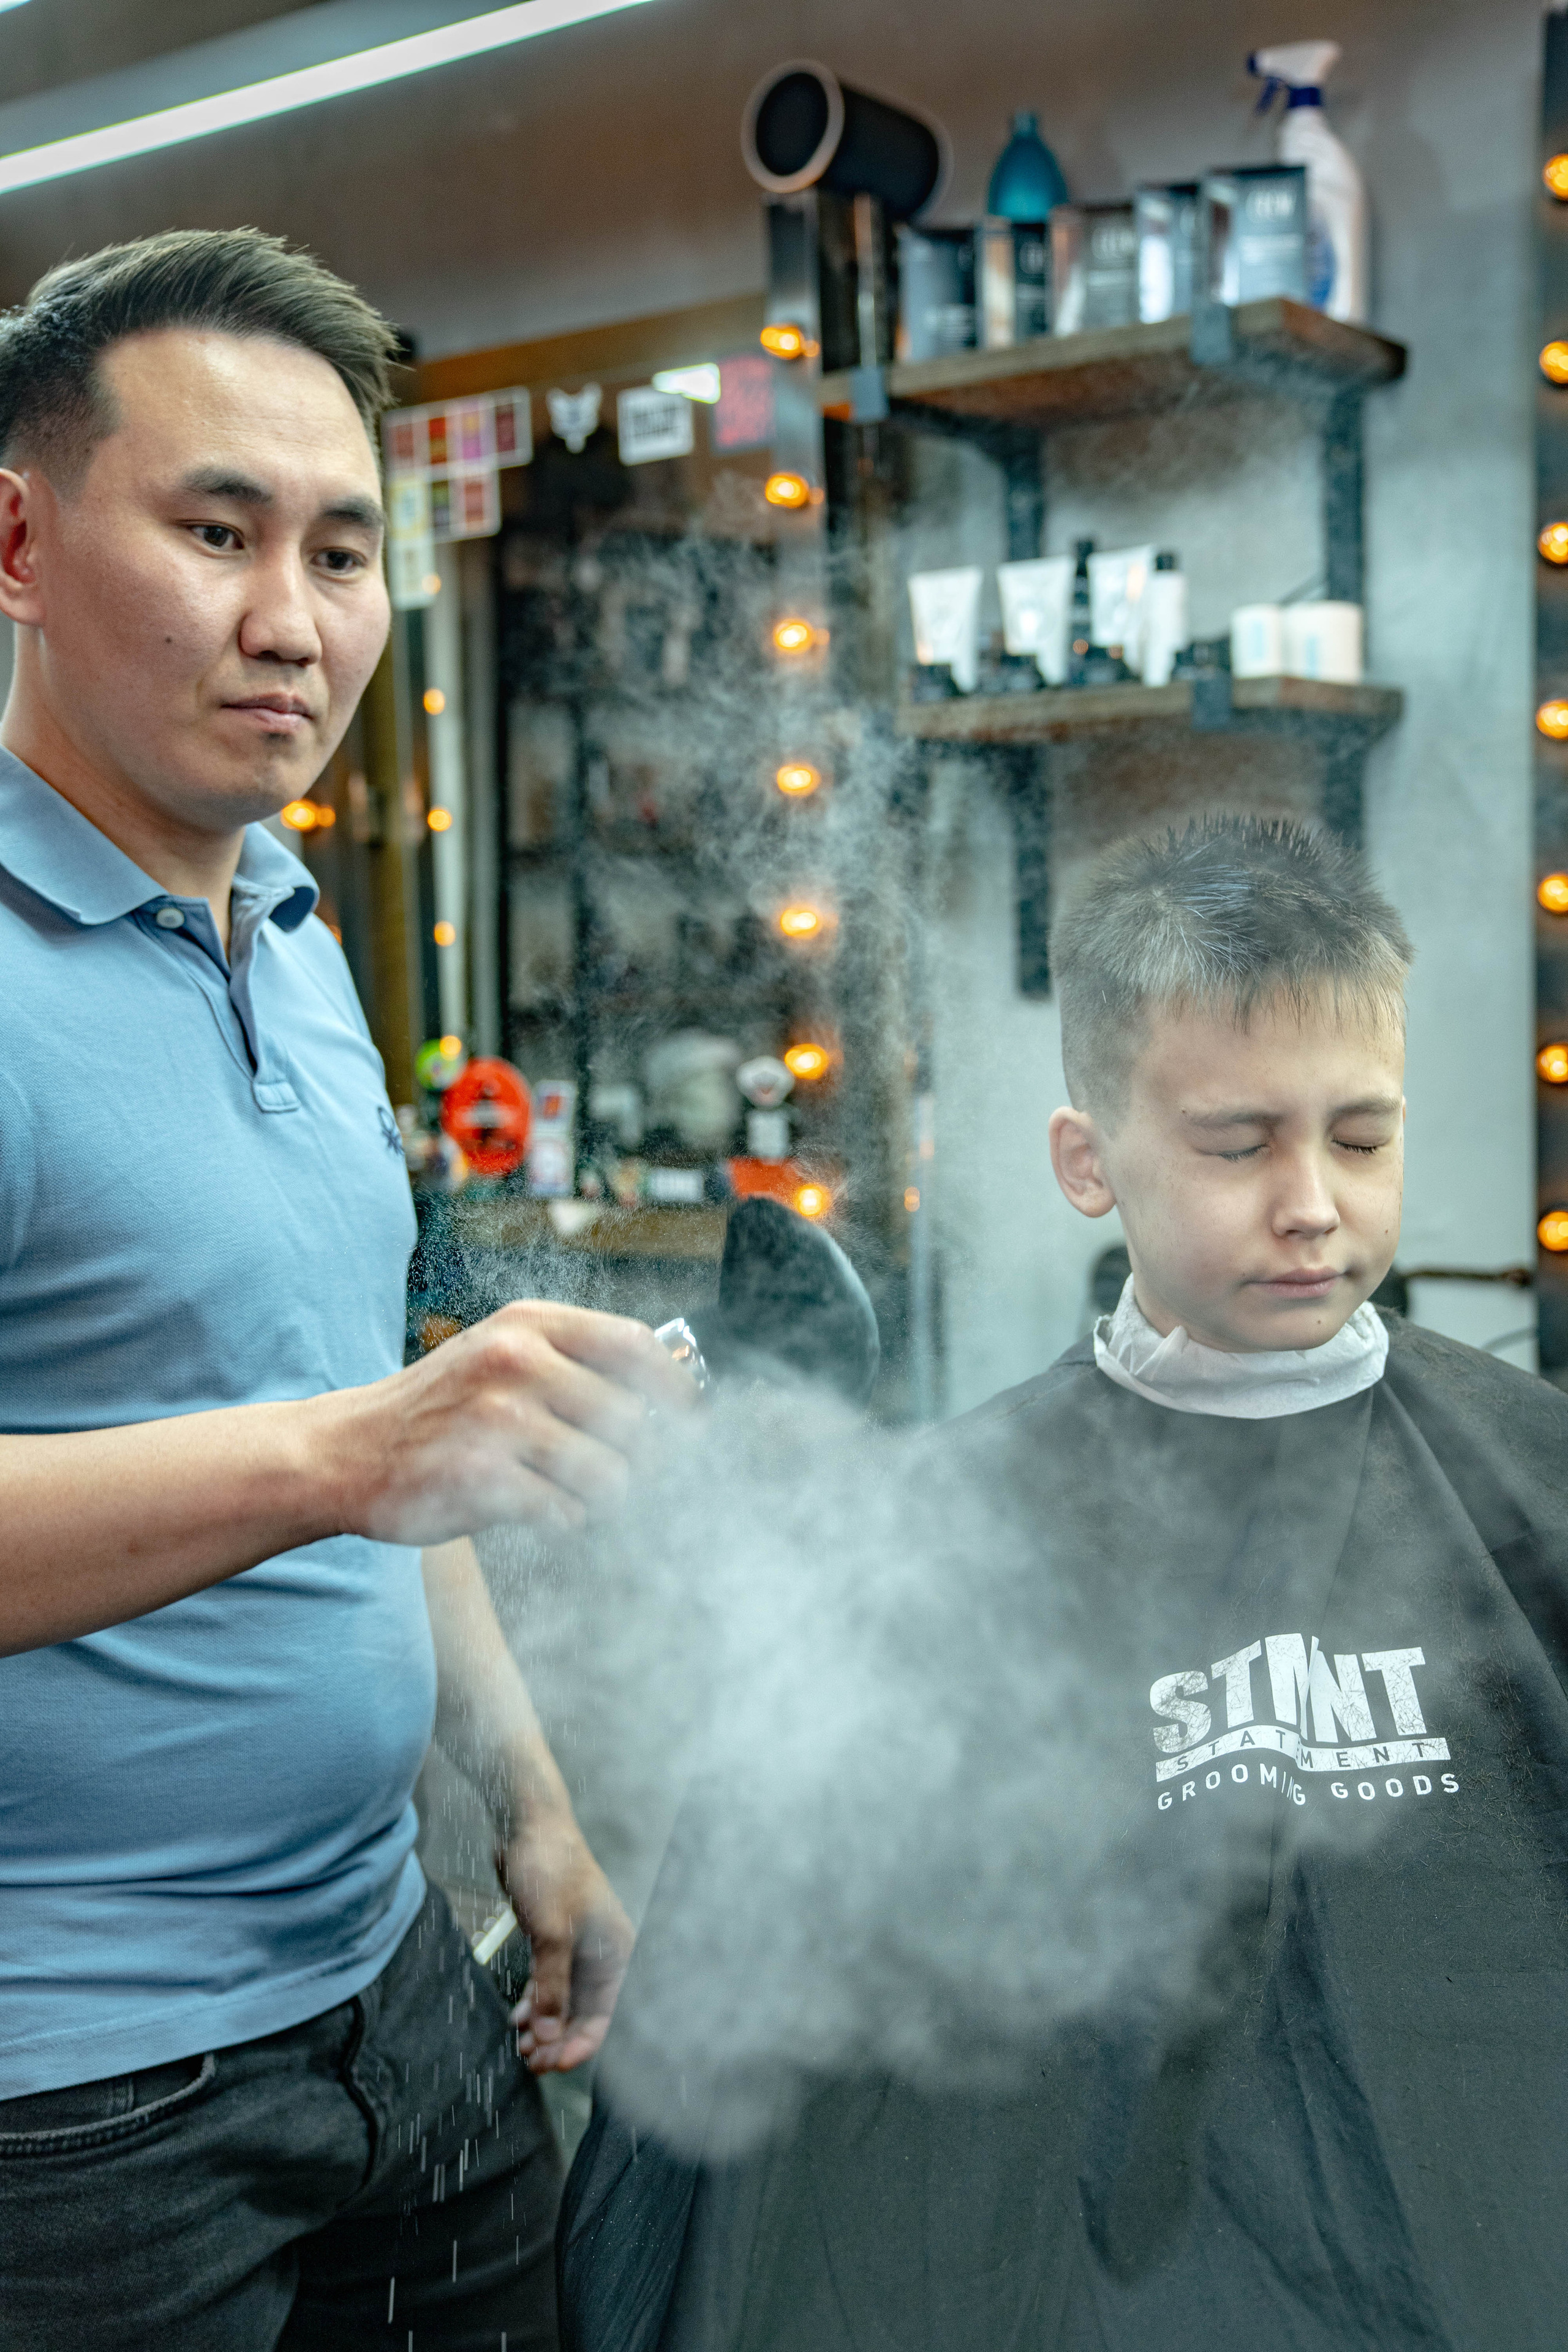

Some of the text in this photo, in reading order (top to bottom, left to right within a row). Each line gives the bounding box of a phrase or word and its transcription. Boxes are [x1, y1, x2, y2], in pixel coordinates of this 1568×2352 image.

[1176, 1729, 1425, 1771] STATMENT
[1157, 1763, 1460, 1810] GROOMING GOODS
